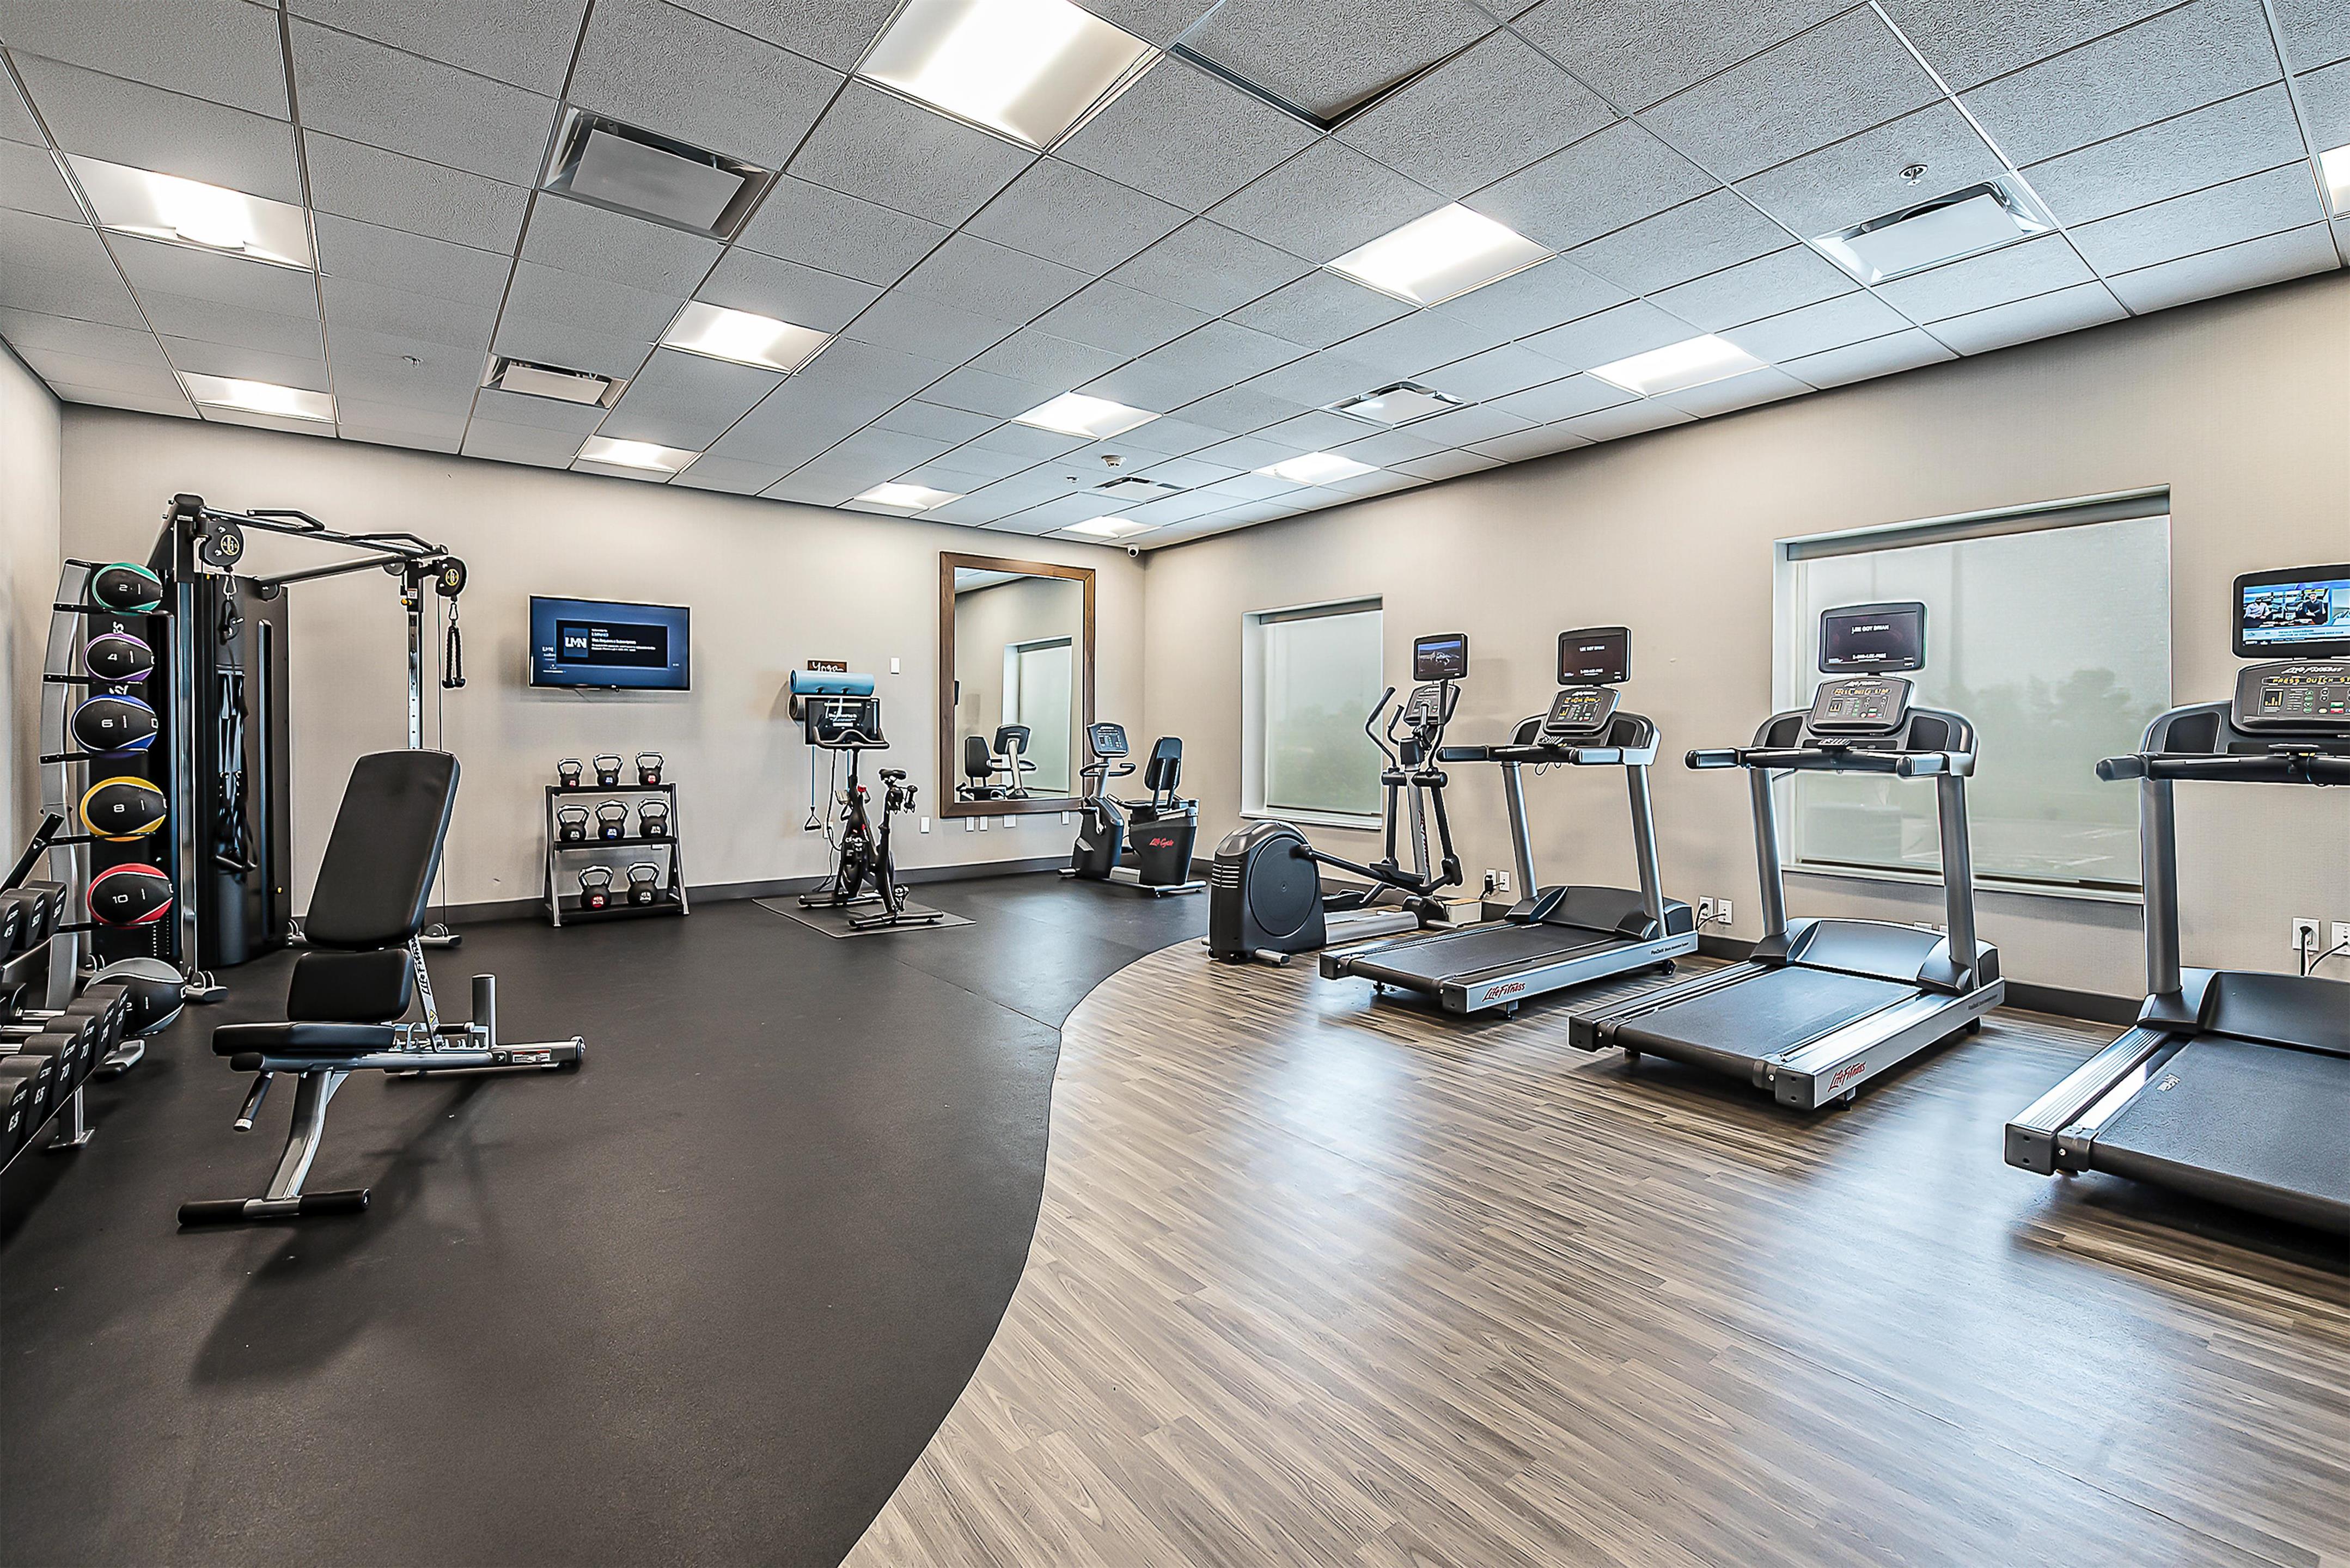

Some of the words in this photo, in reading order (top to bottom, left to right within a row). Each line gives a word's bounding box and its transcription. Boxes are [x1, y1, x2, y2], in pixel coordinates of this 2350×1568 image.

[565, 637, 587, 648] LMN
[812, 661, 844, 672] Yoga
[101, 719, 113, 728] 6
[113, 804, 125, 812] 8
[112, 895, 129, 904] 10
[1482, 982, 1525, 1002] LifeFitness
